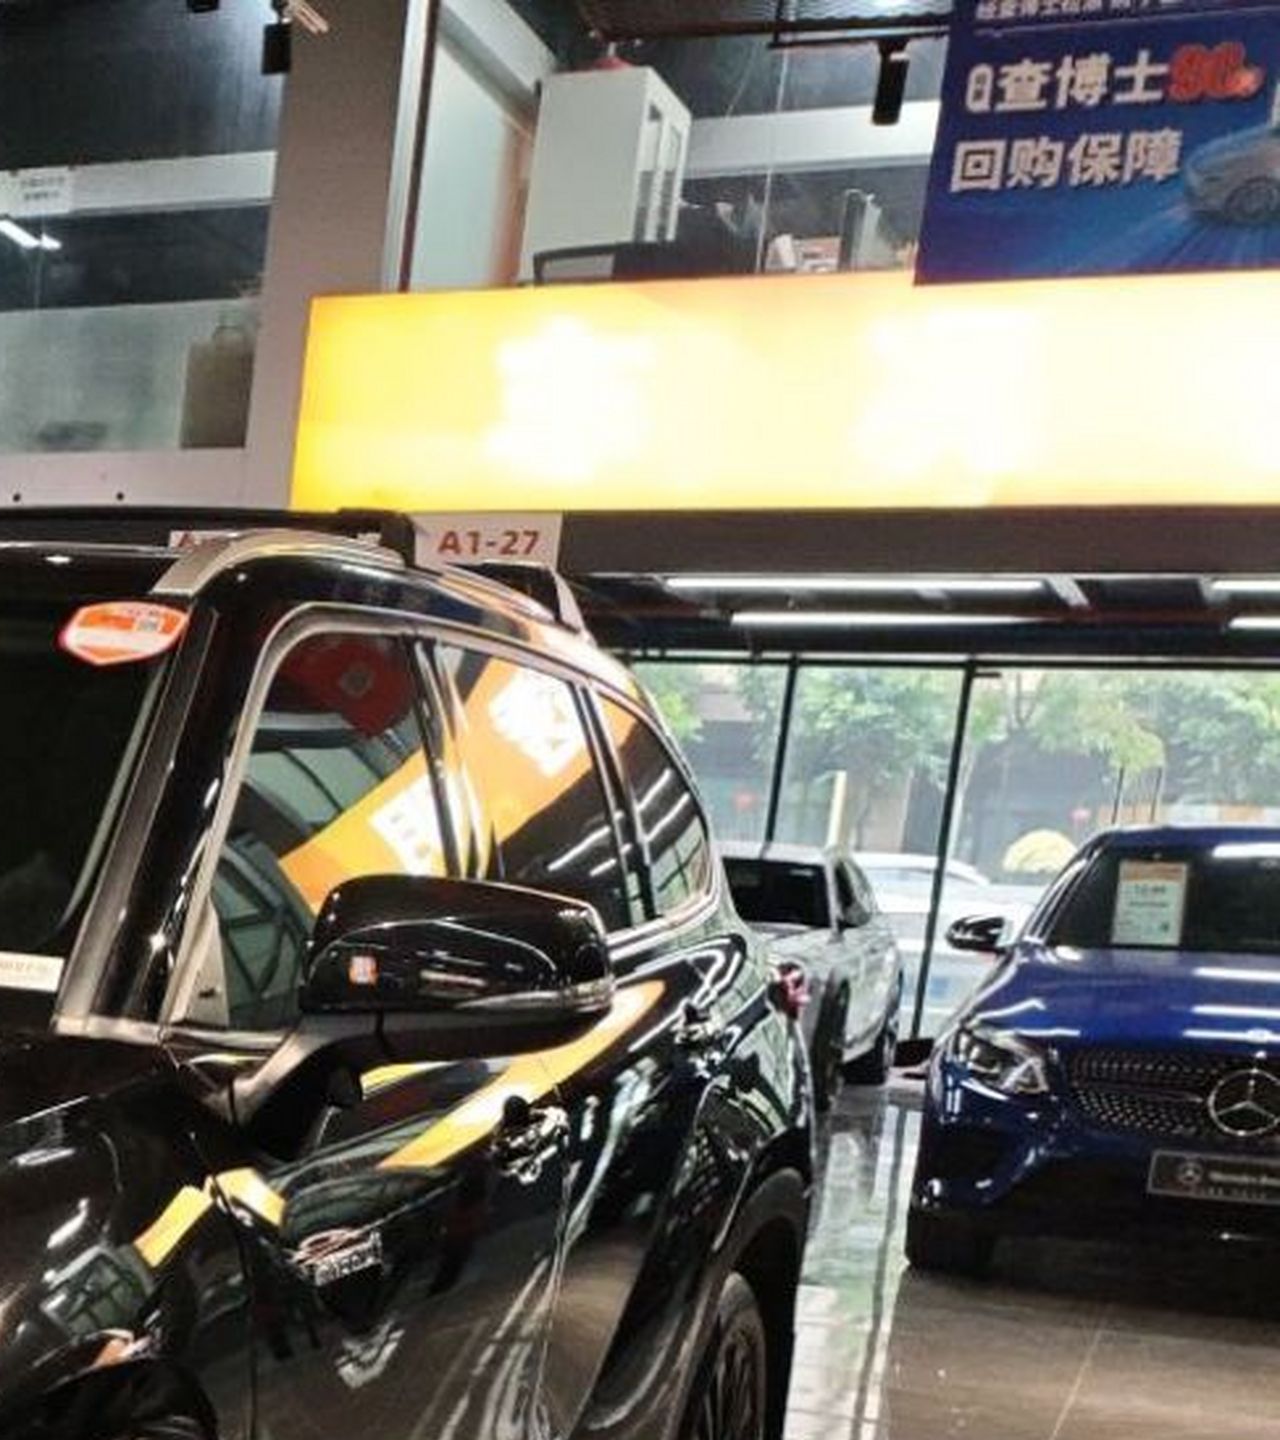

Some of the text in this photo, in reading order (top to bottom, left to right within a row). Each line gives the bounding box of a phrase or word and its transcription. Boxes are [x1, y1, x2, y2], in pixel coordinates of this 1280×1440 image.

[949, 127, 1183, 192] 回购保障
[438, 530, 539, 555] A1-27
